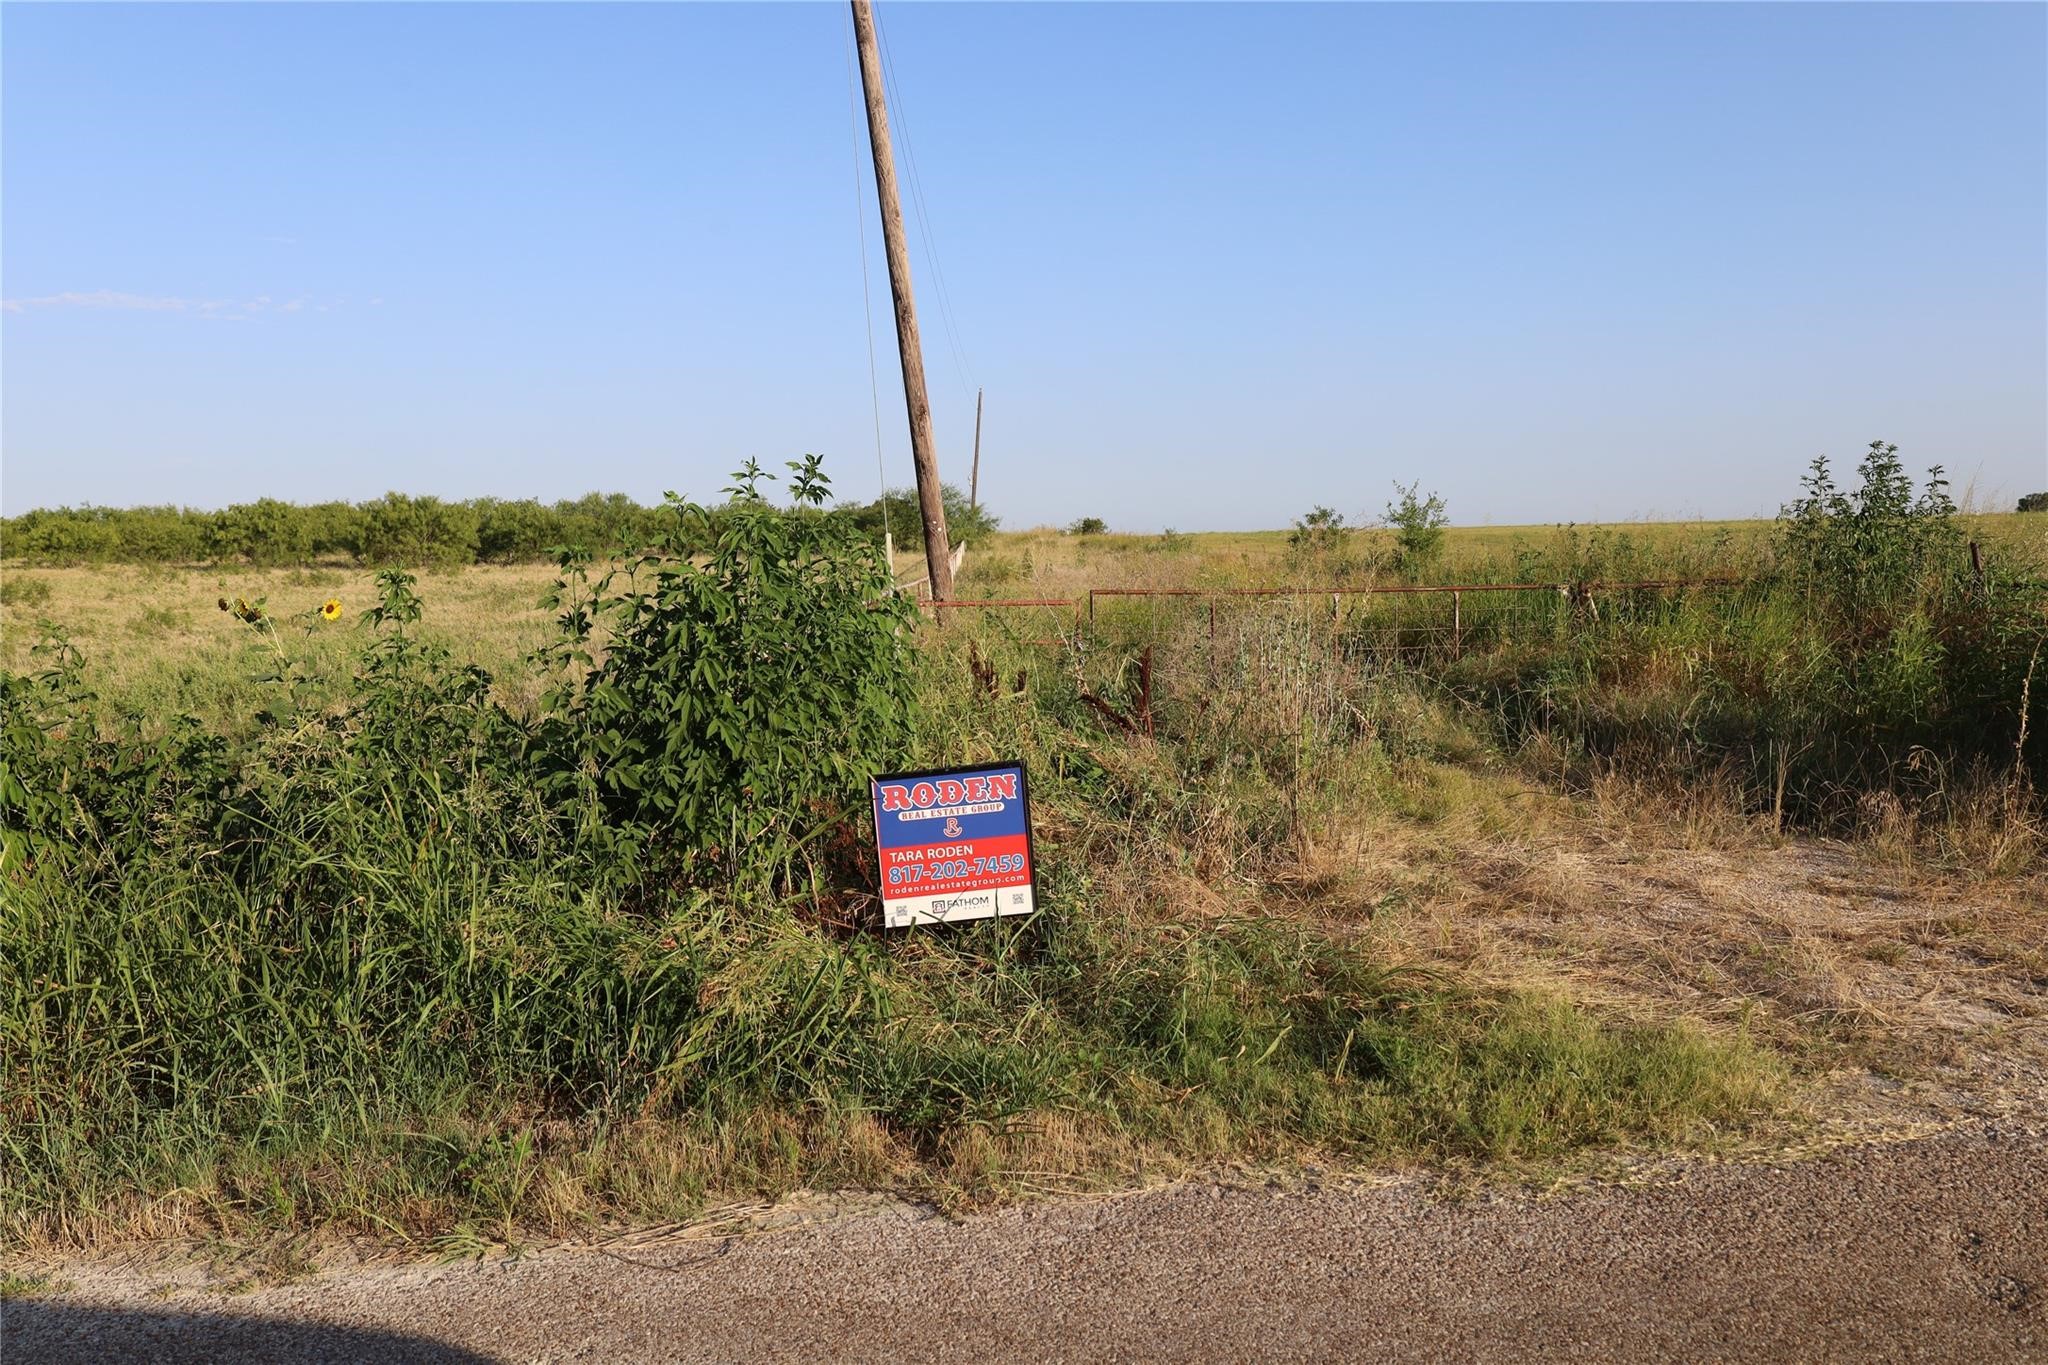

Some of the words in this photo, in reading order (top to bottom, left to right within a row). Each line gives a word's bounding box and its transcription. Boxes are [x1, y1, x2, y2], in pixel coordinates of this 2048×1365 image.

[881, 774, 1017, 812] RODEN
[901, 811, 929, 821] REAL
[931, 807, 968, 817] ESTATE
[971, 803, 1002, 812] GROUP
[889, 850, 924, 863] TARA
[927, 845, 973, 859] RODEN
[889, 854, 1025, 884] 817-202-7459
[947, 896, 989, 907] FATHOM
